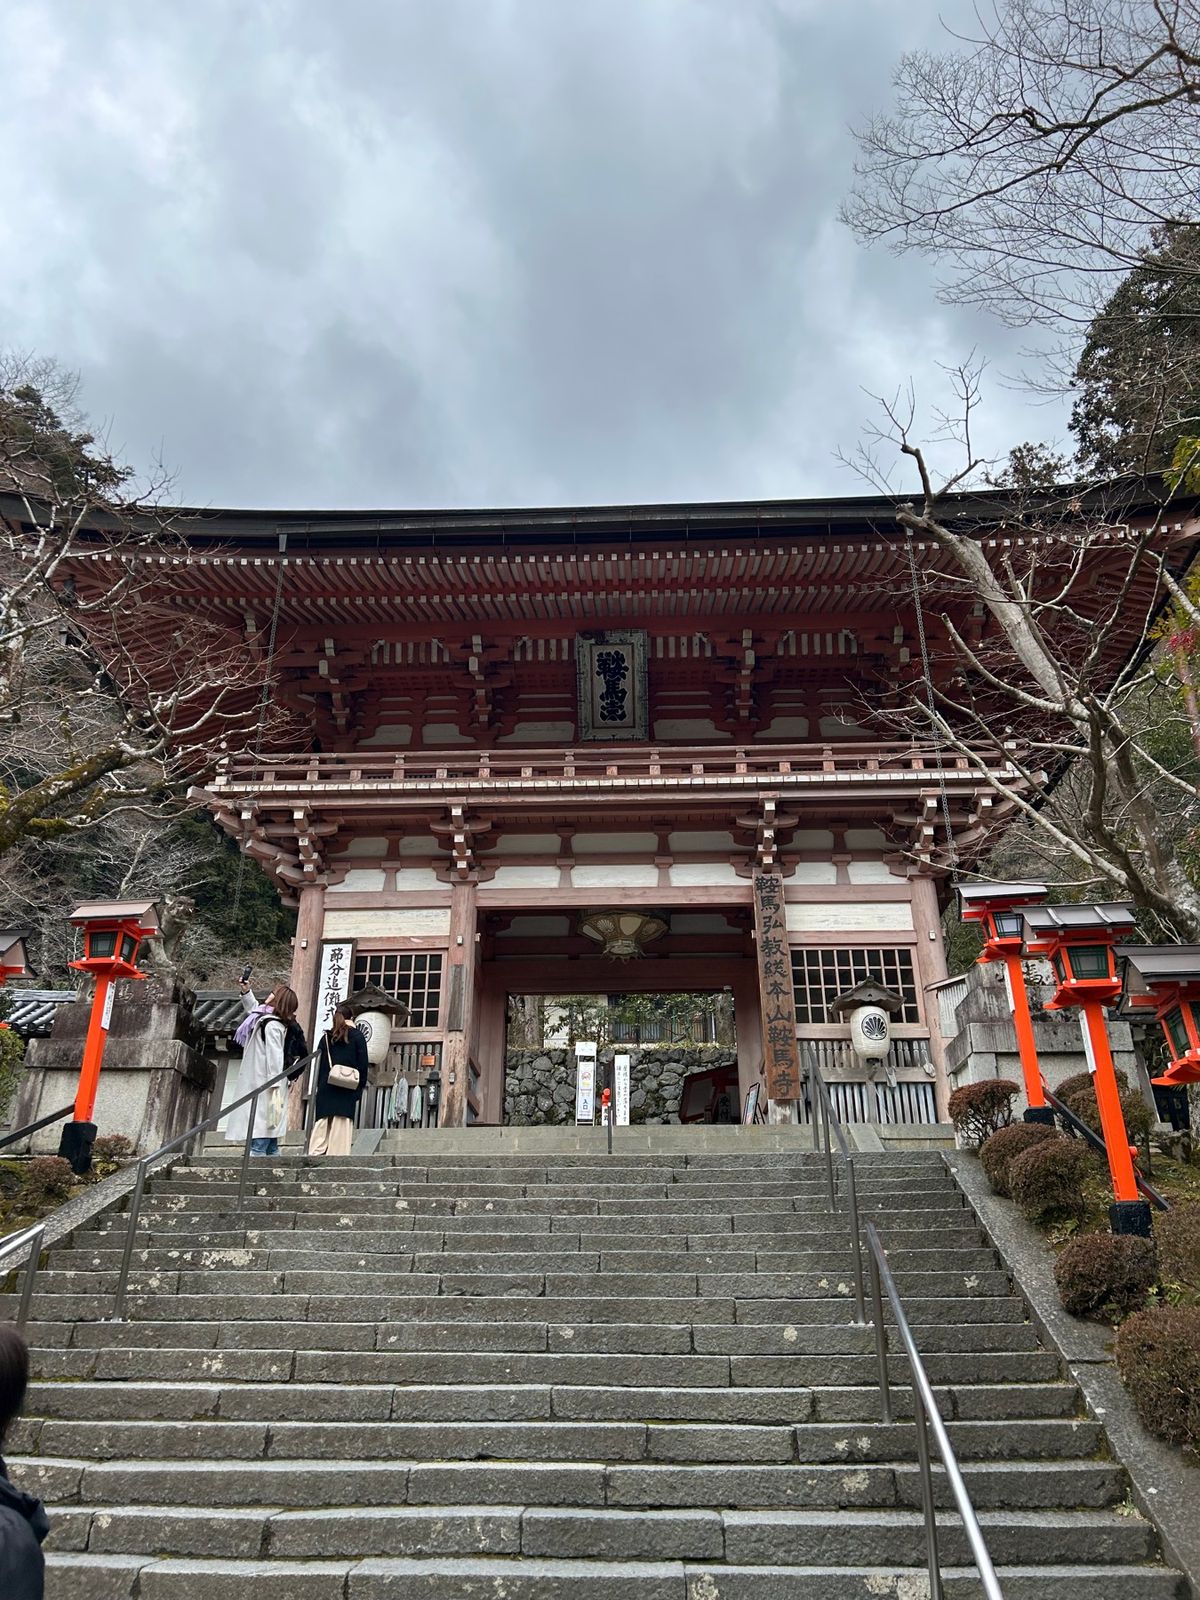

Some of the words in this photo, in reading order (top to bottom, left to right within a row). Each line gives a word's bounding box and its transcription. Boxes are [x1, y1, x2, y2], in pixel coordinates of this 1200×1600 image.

[755, 875, 795, 1097] 鞍馬弘教総本山鞍馬寺
